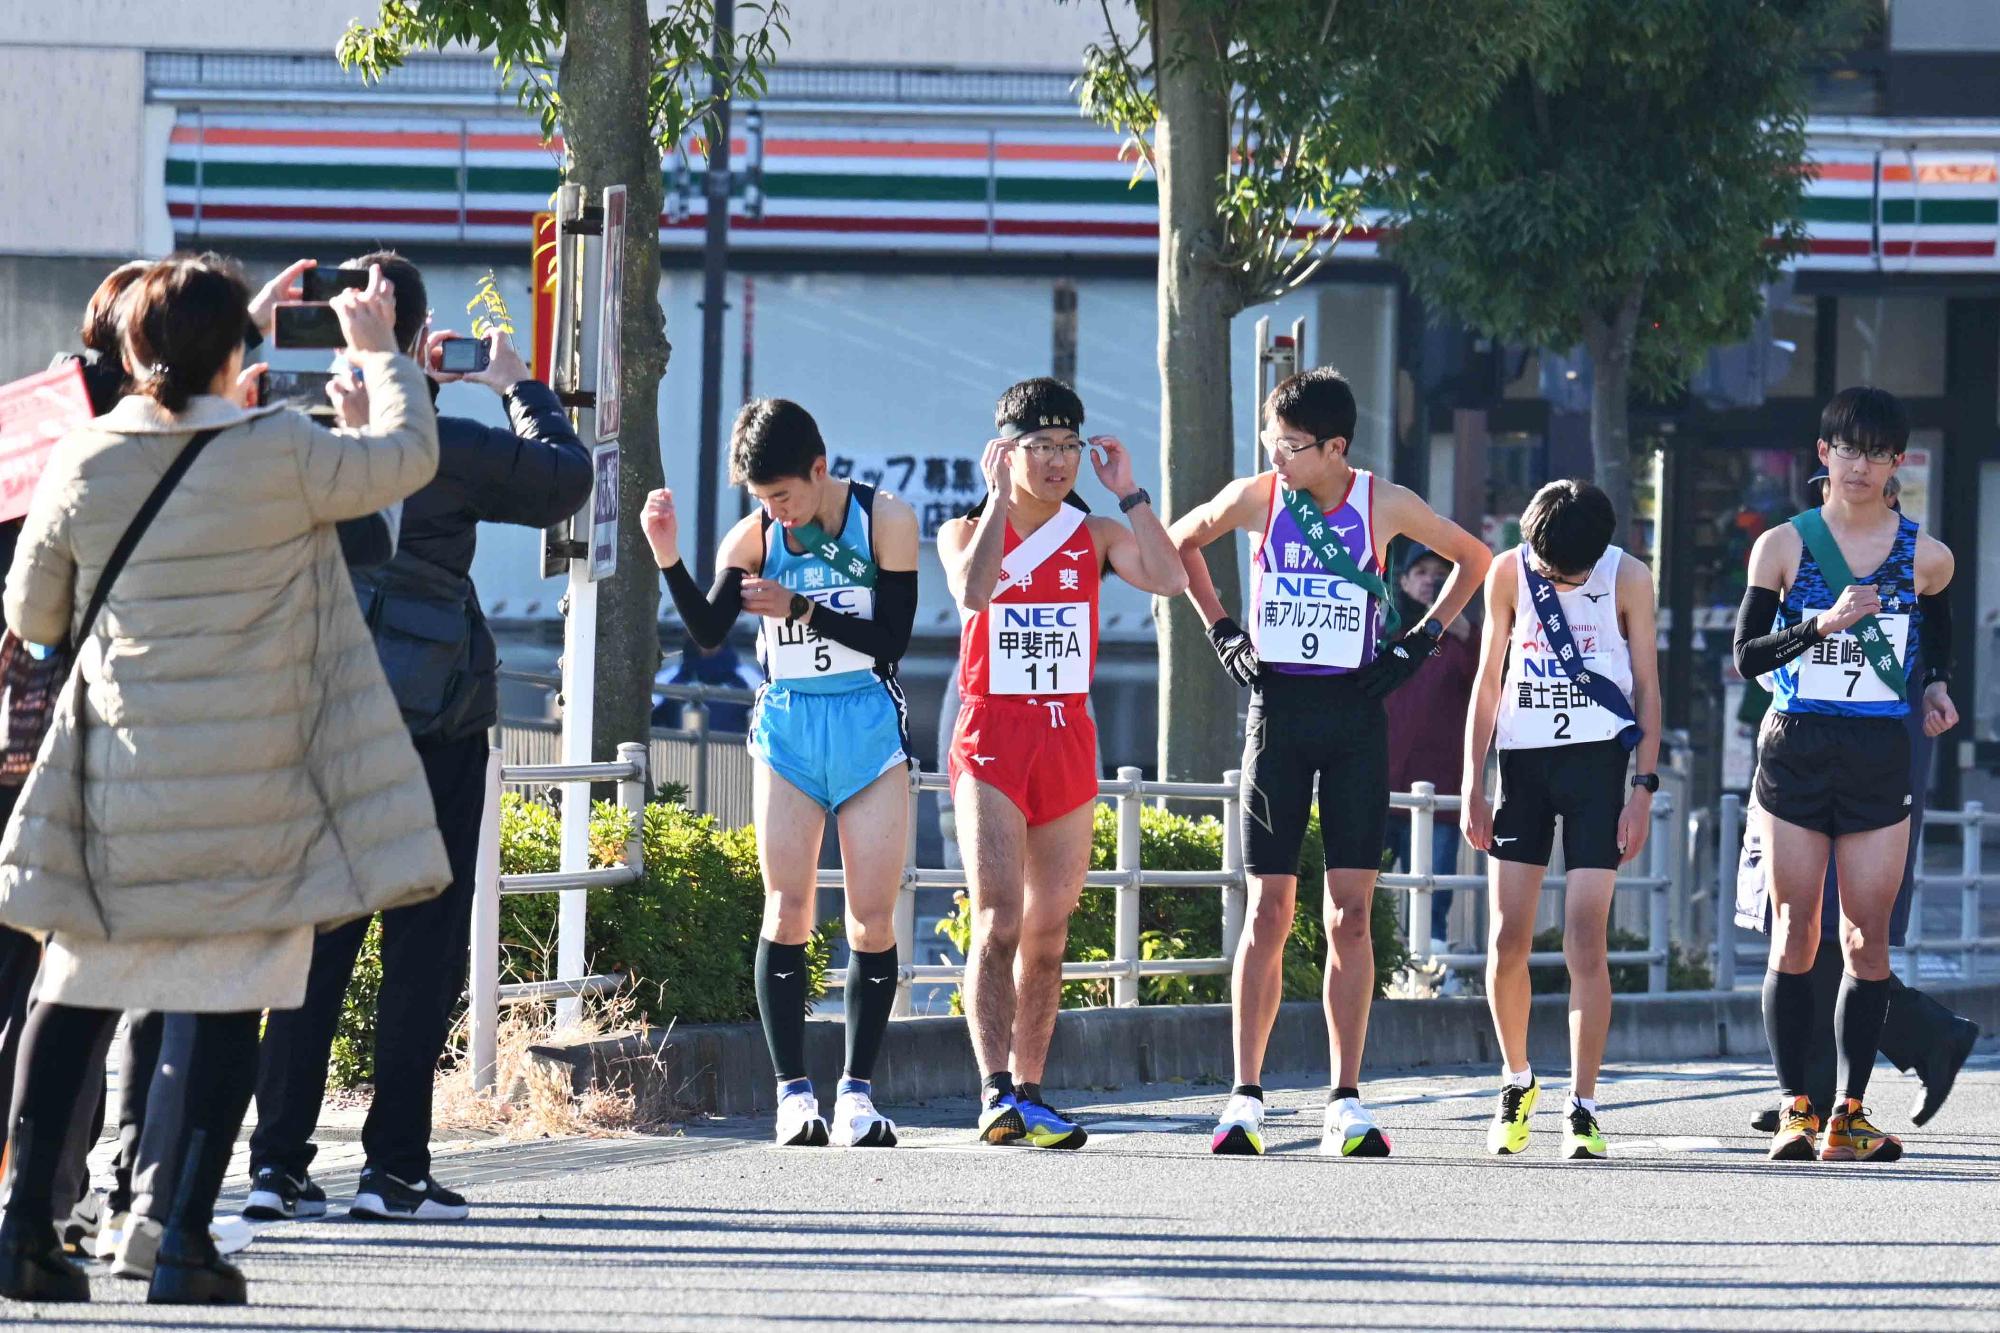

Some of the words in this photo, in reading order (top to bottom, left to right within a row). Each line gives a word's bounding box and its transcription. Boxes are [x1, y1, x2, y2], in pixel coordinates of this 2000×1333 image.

[1275, 576, 1353, 601] NEC
[1004, 606, 1077, 628] NEC
[1264, 600, 1361, 633] 南アルプス市B
[814, 645, 832, 672] 5
[999, 631, 1082, 660] 甲斐市A
[1301, 632, 1319, 660] 9
[1025, 662, 1059, 691] 11
[1843, 670, 1862, 698] 7
[1553, 713, 1571, 739] 2
